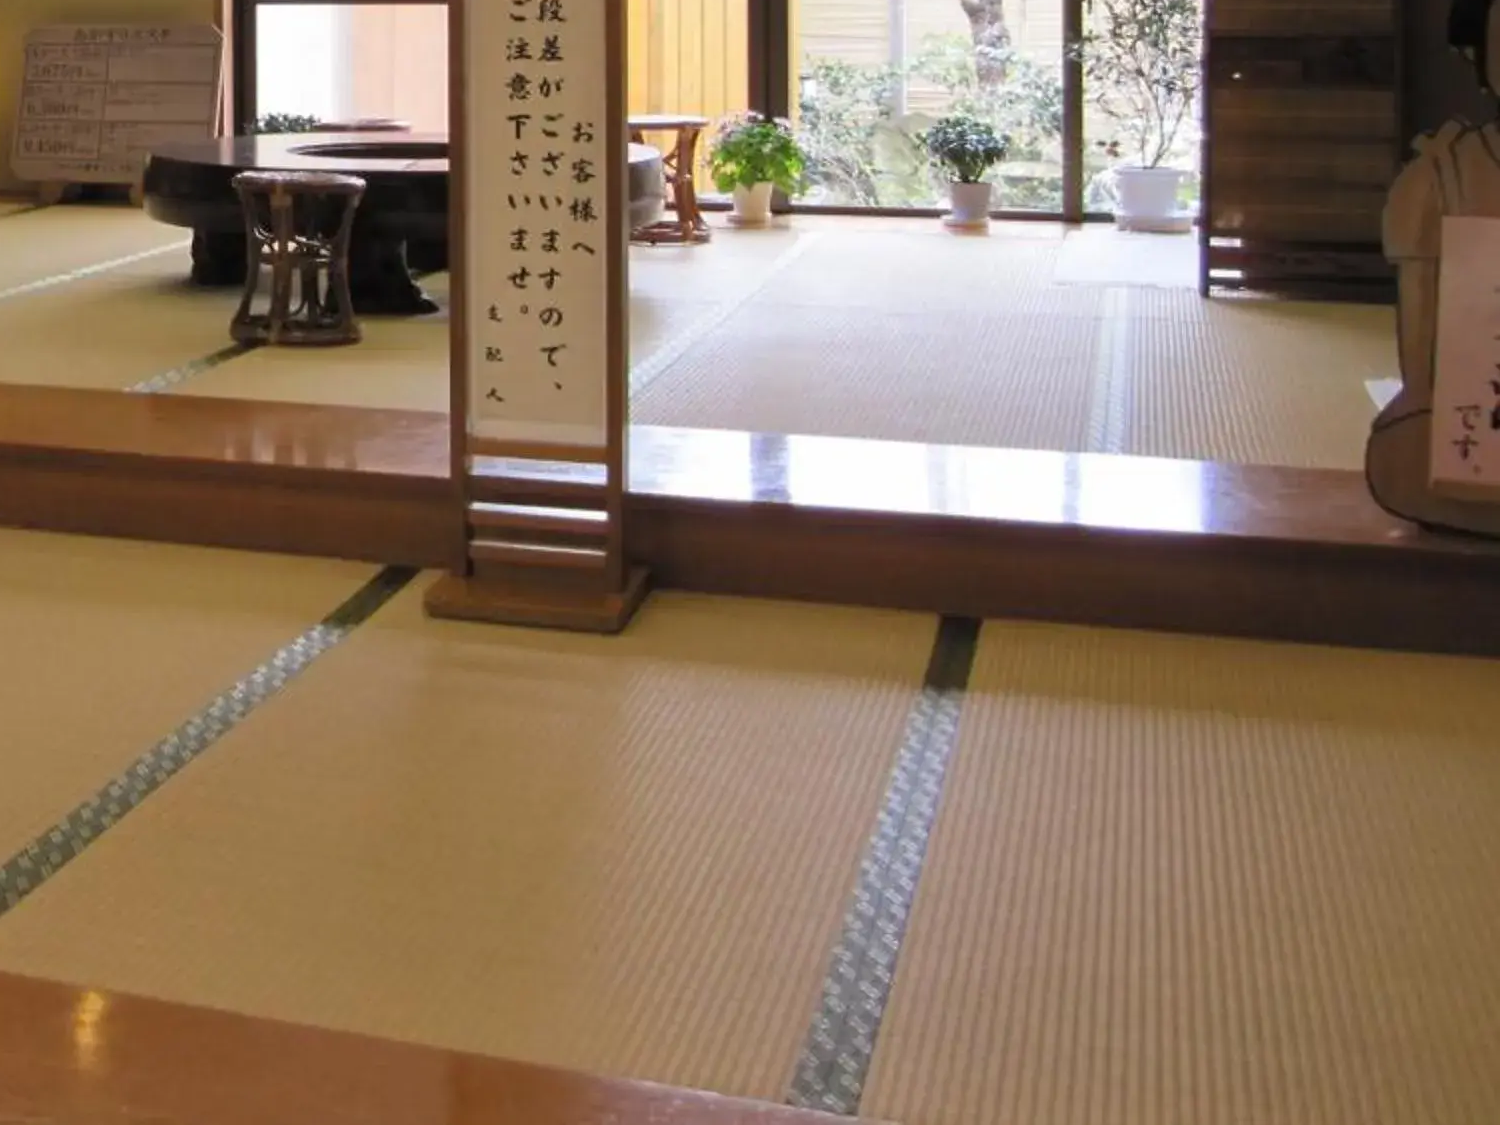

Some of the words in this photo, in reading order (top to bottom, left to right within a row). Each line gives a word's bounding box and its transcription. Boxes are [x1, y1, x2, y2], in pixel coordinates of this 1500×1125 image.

[569, 122, 598, 257] お客様へ
[484, 304, 504, 403] 支配人
